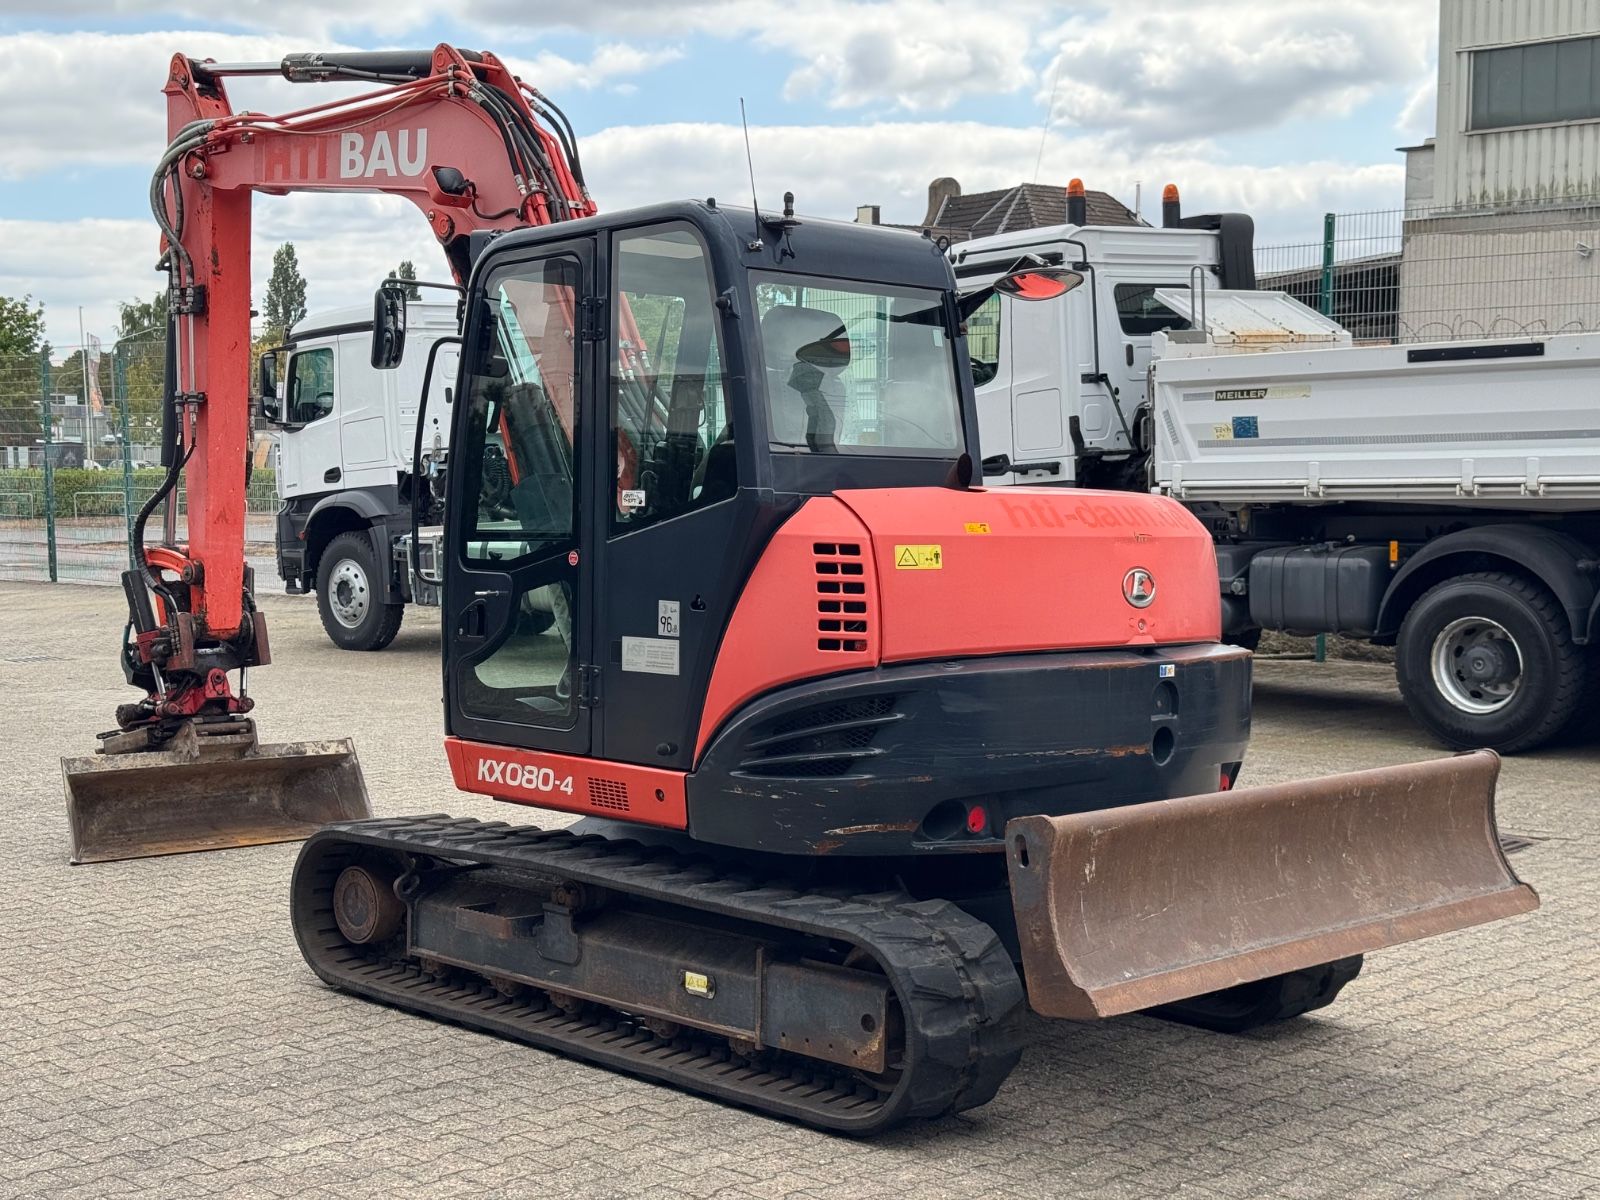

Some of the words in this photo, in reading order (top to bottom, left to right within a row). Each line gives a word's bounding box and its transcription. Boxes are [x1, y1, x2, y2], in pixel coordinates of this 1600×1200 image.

[265, 138, 328, 180] HTI
[340, 128, 428, 179] BAU
[1216, 389, 1266, 400] MEILLER
[660, 615, 673, 633] 96
[477, 758, 574, 796] KX080-4
